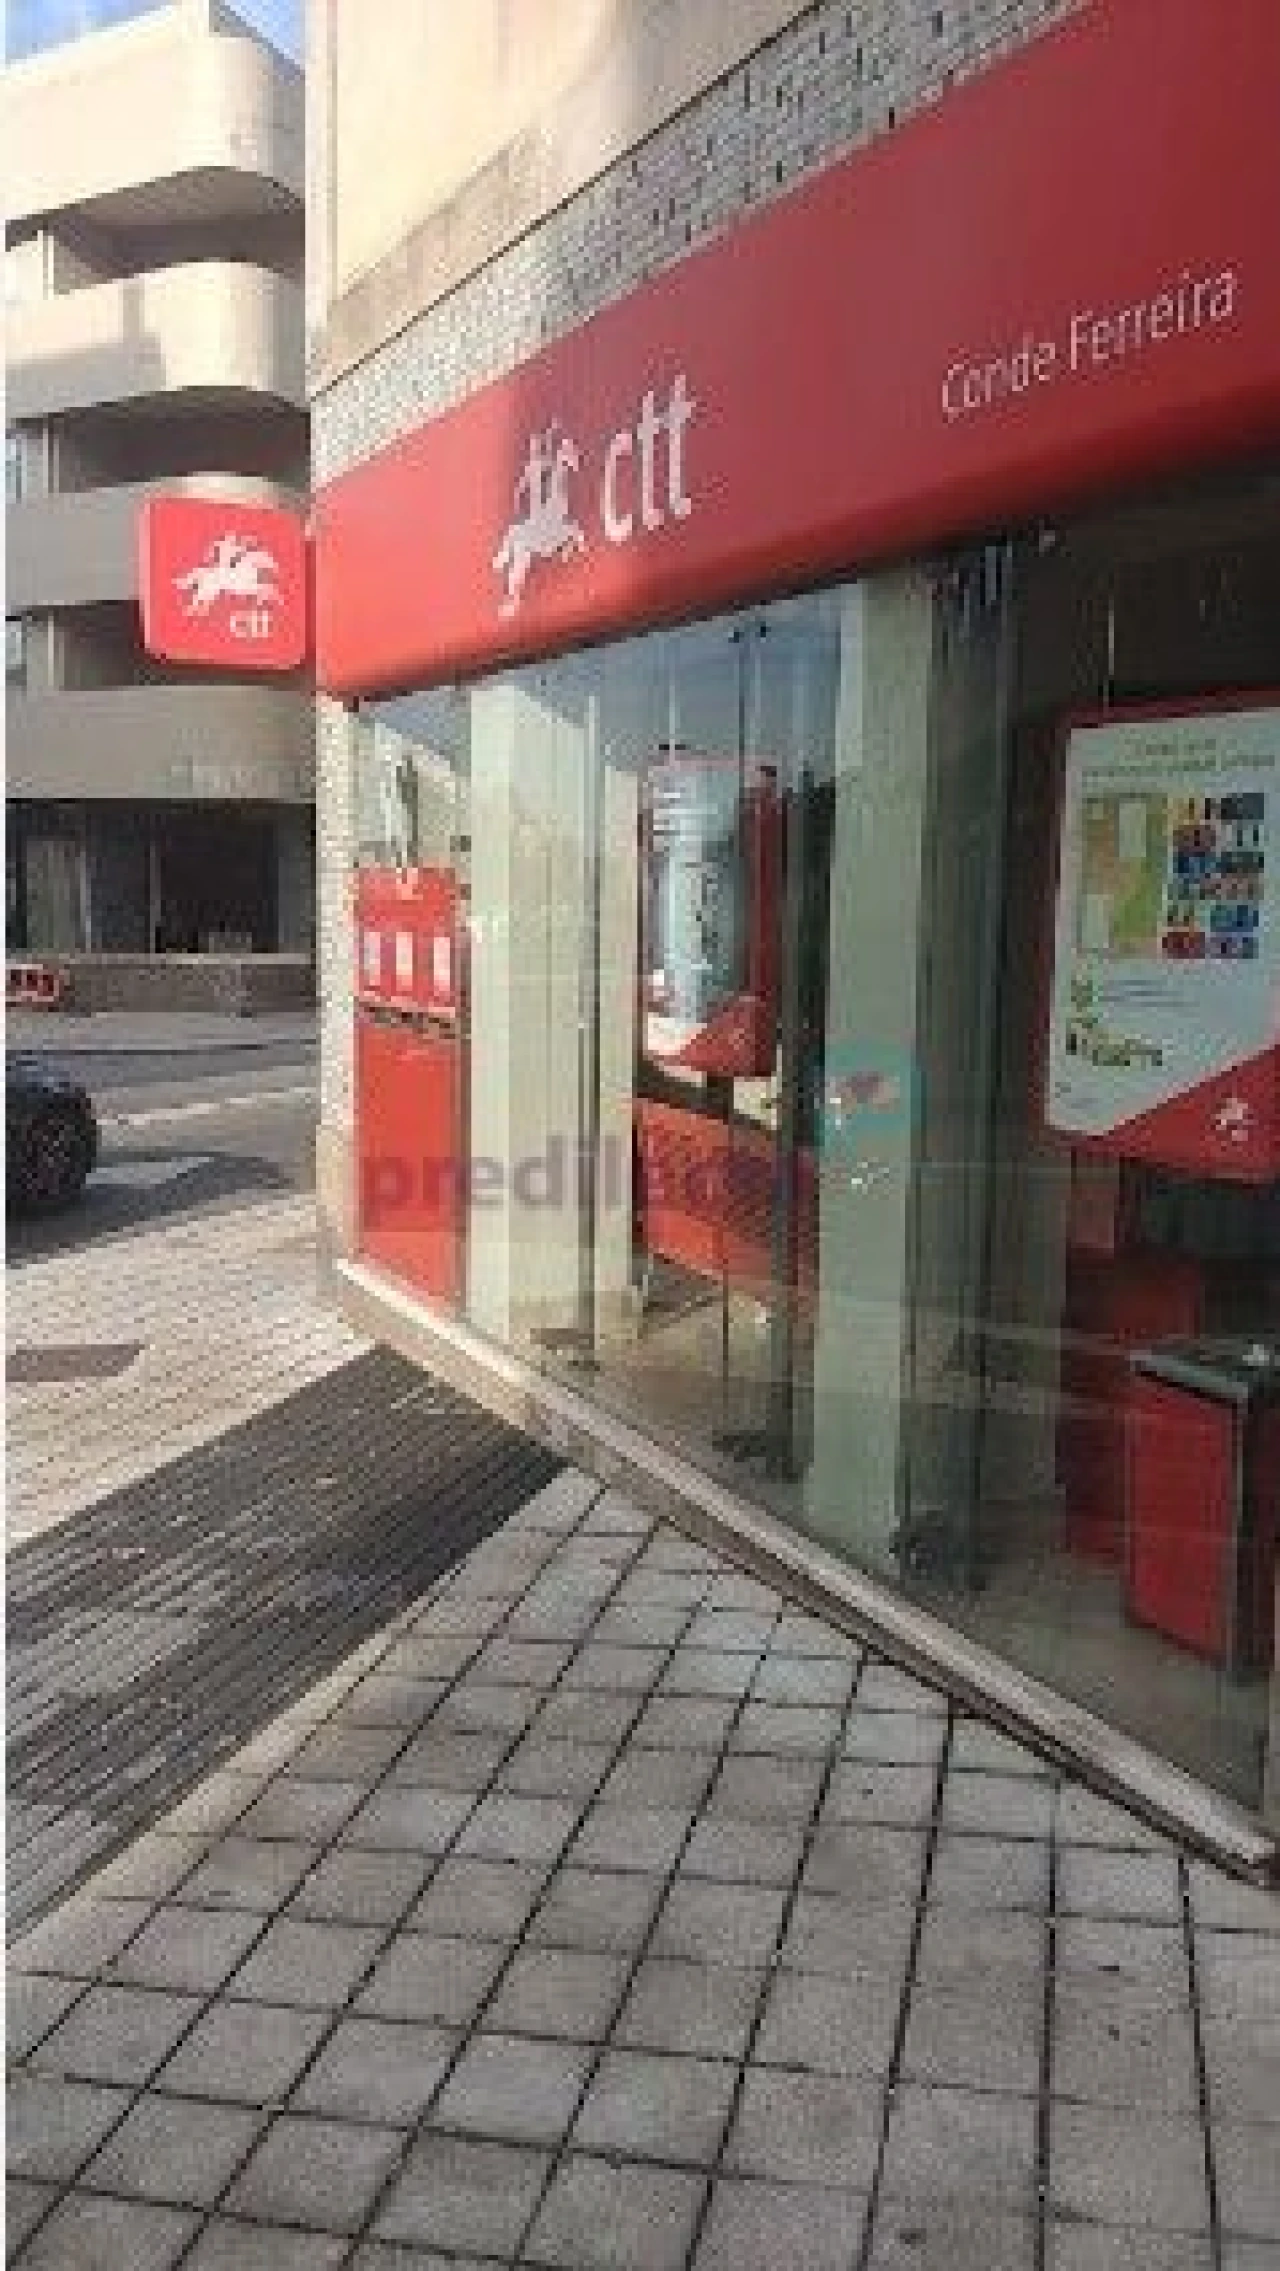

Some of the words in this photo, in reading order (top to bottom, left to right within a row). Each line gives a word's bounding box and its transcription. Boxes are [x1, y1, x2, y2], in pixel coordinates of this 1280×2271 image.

[942, 332, 1056, 414] Conde
[1070, 268, 1237, 371] Ferreira
[604, 373, 696, 541] ctt
[229, 610, 269, 638] ctt
